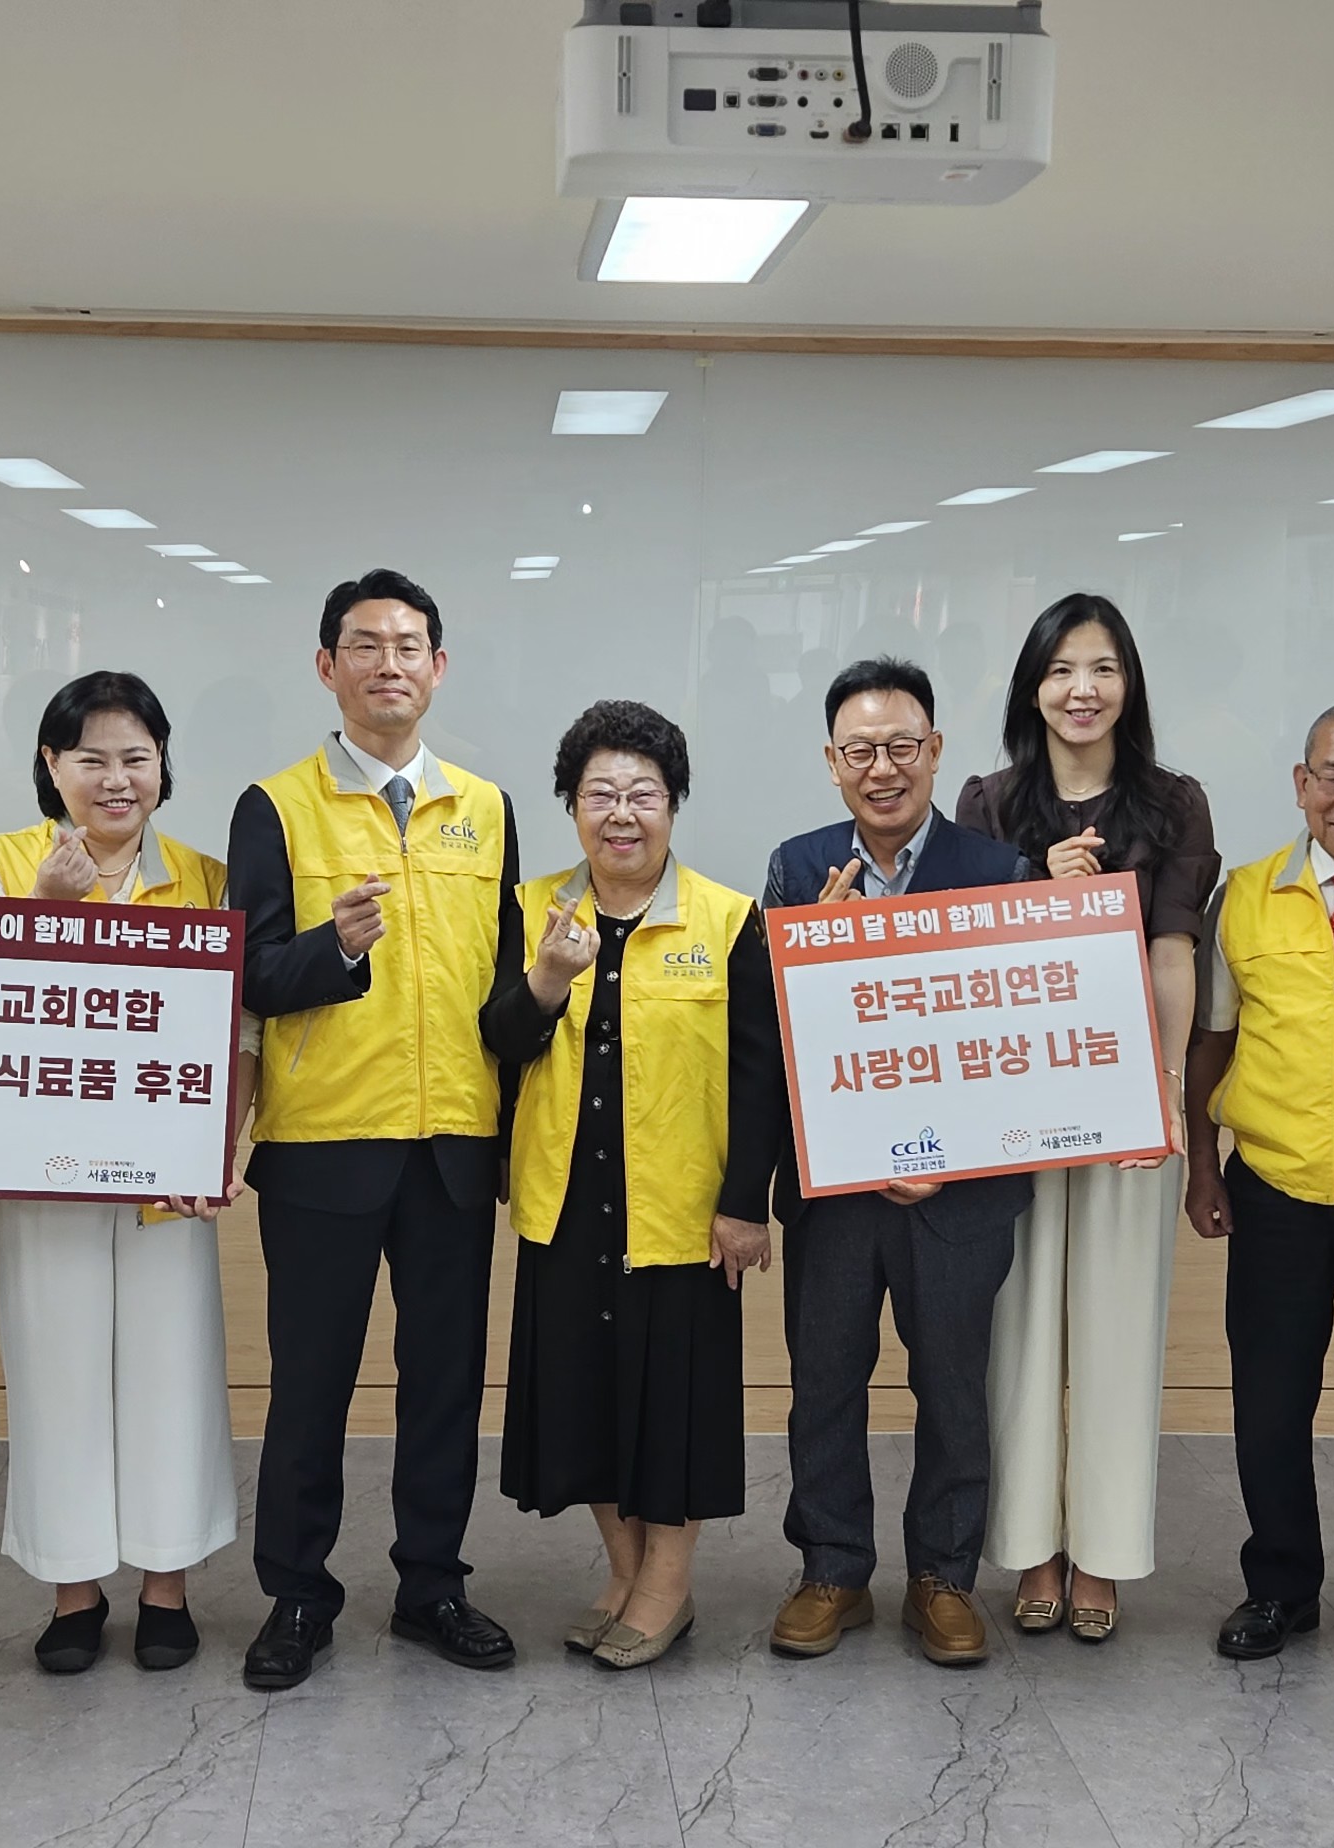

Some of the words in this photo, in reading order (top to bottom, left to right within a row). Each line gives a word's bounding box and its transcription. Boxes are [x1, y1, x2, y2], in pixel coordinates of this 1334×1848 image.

[441, 824, 478, 841] CCIK
[784, 916, 855, 949] 가정의
[863, 916, 886, 943] 달
[893, 908, 941, 939] 맞이
[947, 903, 996, 933] 함께
[1003, 896, 1072, 926] 나누는
[1080, 888, 1126, 919] 사랑
[34, 915, 85, 946] 함께
[94, 919, 169, 951] 나누는
[178, 923, 231, 953] 사랑
[664, 952, 711, 965] CCIK
[850, 960, 1080, 1024] 한국교회연합
[830, 1044, 942, 1093] 사랑의
[956, 1034, 1031, 1081] 밥상
[1045, 1026, 1119, 1068] 나눔
[134, 1059, 213, 1105] 후원
[891, 1139, 944, 1156] CCIK
[1040, 1131, 1103, 1149] 서울연탄은행
[893, 1160, 945, 1174] 한국교회연합
[87, 1169, 157, 1185] 서울연탄은행
